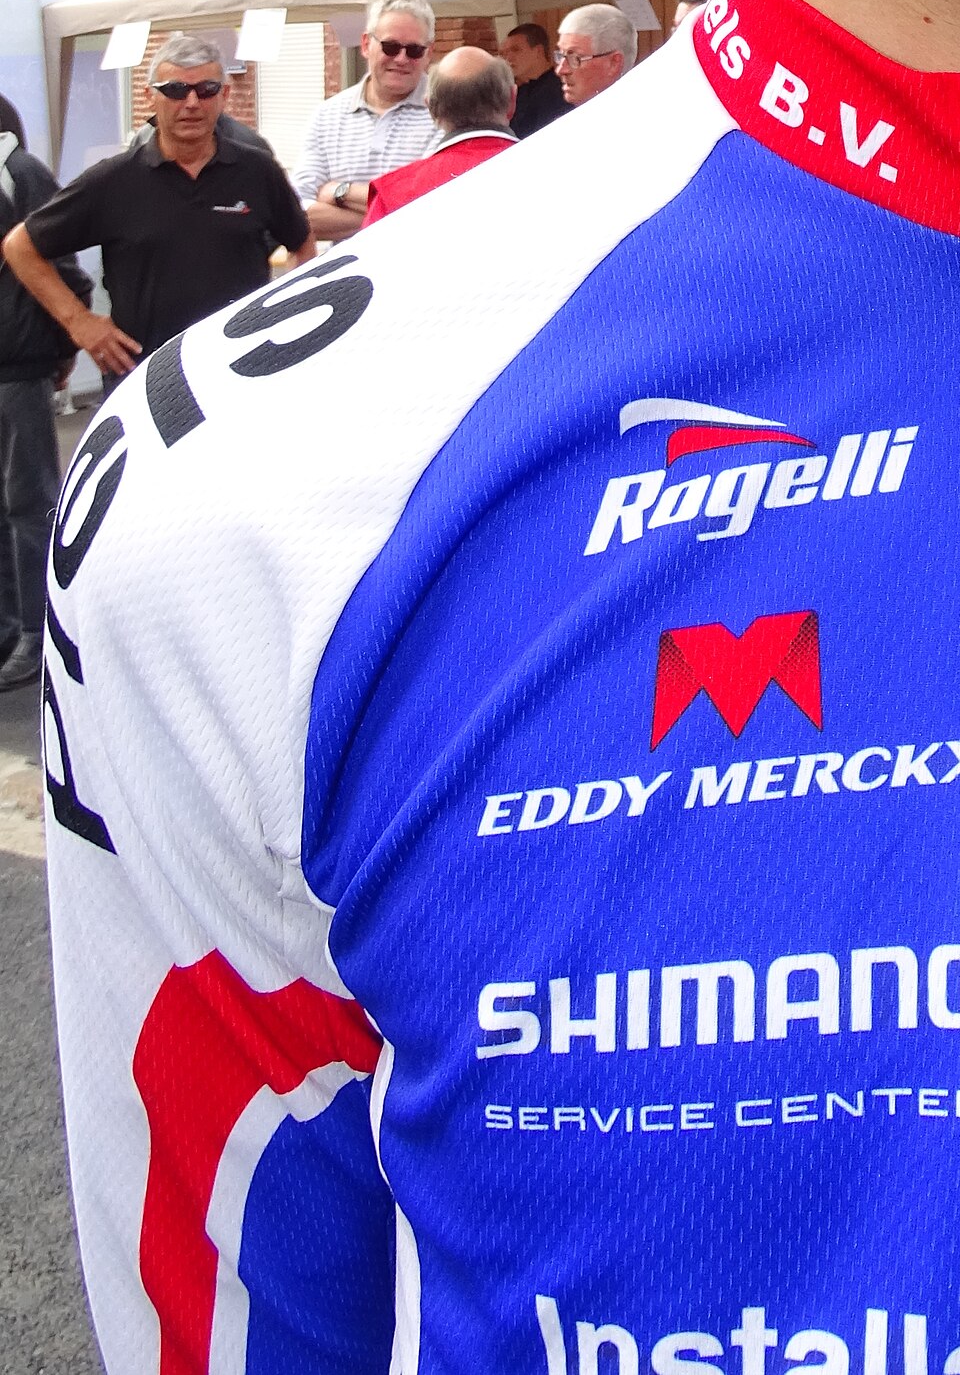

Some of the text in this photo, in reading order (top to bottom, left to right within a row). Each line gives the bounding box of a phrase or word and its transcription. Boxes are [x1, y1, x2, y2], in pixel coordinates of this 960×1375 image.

[758, 60, 899, 183] B.V.
[584, 425, 919, 556] Rogelli
[476, 772, 673, 837] EDDY
[484, 1101, 716, 1134] SERVICE
